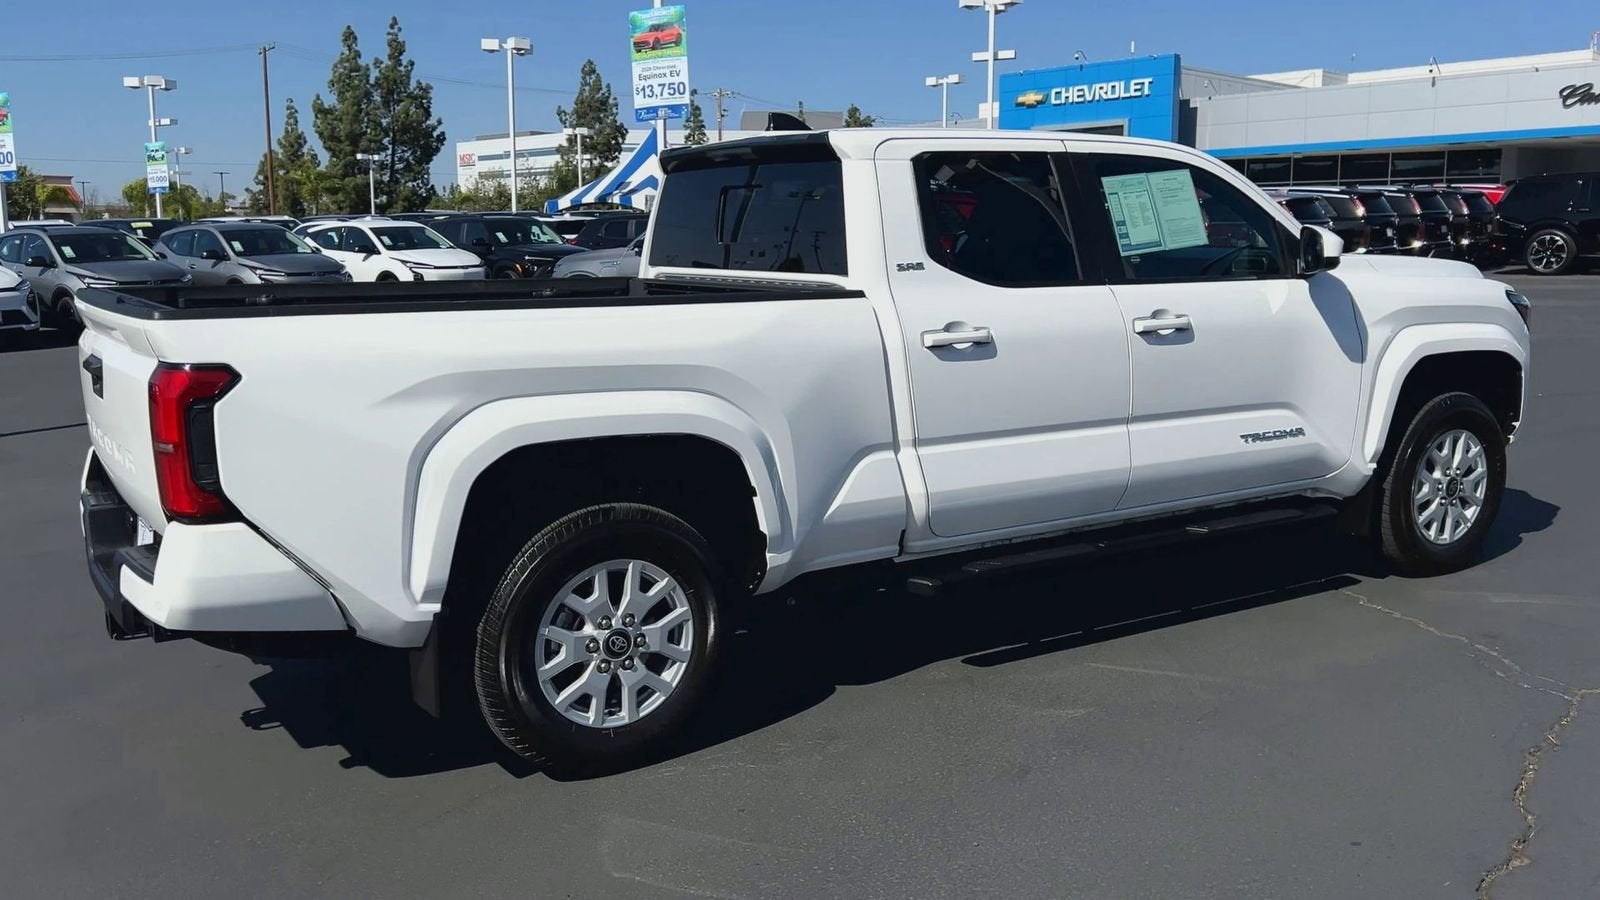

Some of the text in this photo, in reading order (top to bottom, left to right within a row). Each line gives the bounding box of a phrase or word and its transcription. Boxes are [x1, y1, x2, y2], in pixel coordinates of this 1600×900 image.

[638, 69, 681, 82] Equinox EV
[635, 81, 687, 100] $13,750
[1051, 77, 1153, 105] CHEVROLET
[86, 413, 137, 474] TACOMA
[1239, 426, 1306, 444] TACOMA
